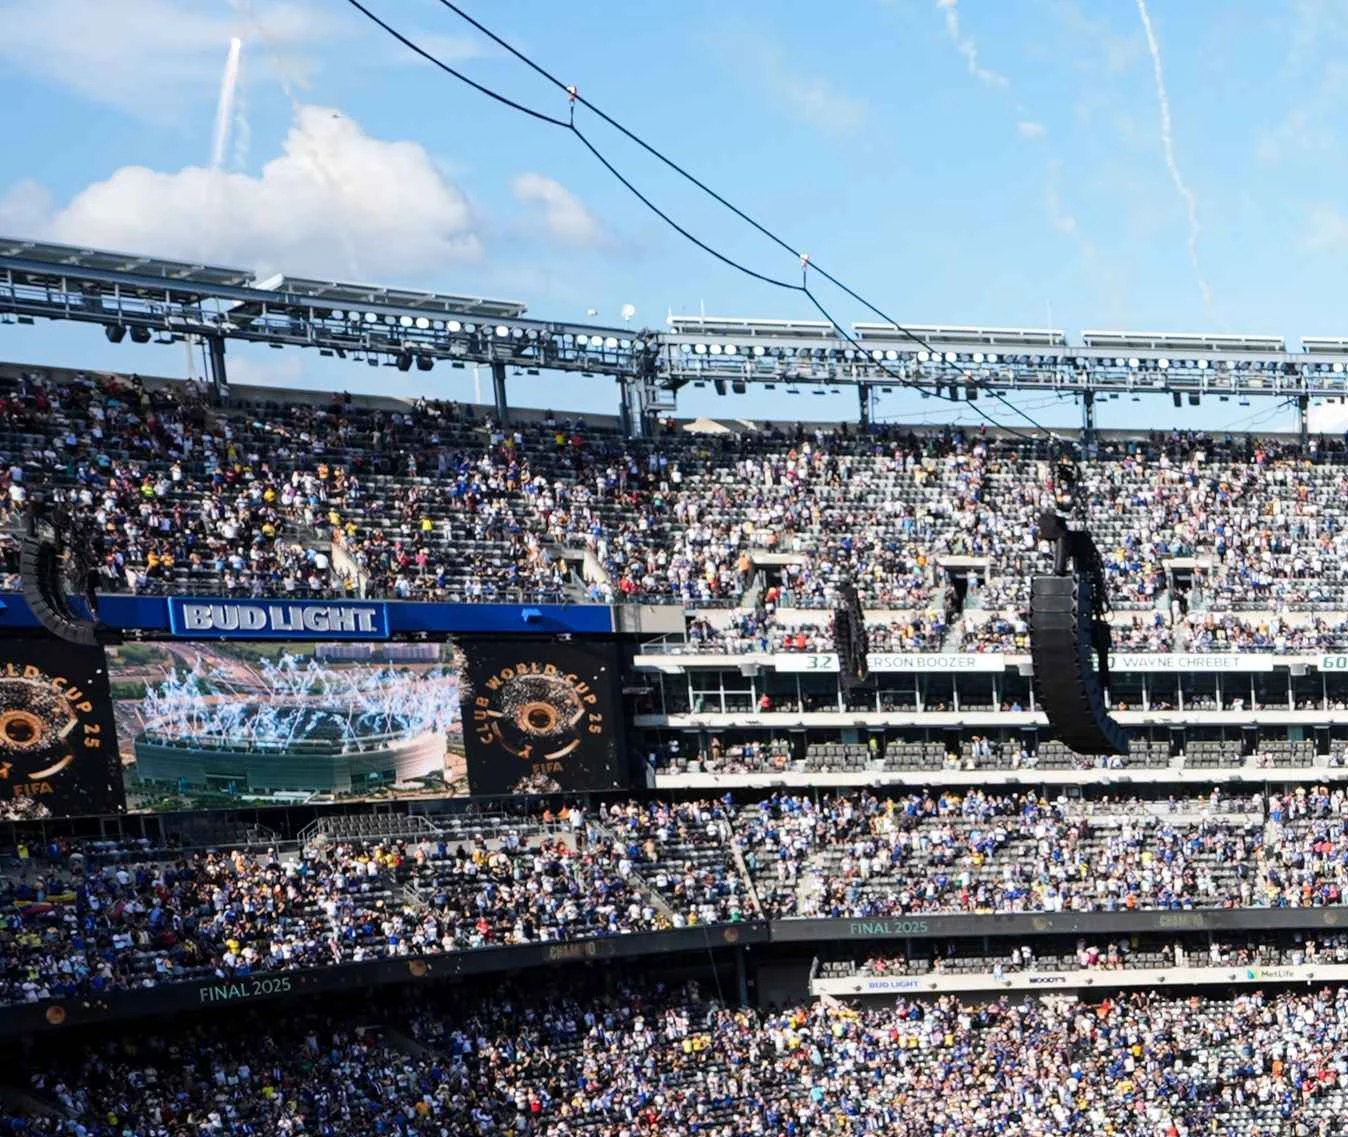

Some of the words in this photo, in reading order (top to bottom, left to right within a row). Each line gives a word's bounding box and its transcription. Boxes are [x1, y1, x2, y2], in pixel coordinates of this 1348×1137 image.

[183, 604, 266, 630] BUD
[269, 605, 377, 632] LIGHT
[807, 656, 832, 669] 32
[917, 657, 976, 667] BOOZER
[1123, 657, 1173, 667] WAYNE
[1179, 657, 1240, 667] CHREBET
[1323, 656, 1347, 668] 60
[52, 677, 93, 713] CUP
[473, 696, 493, 744] CLUB
[484, 662, 557, 690] WORLD
[565, 674, 597, 704] CUP
[532, 761, 563, 773] FIFA
[12, 782, 53, 797] FIFA
[850, 922, 891, 934] FINAL
[894, 921, 928, 934] 2025
[1261, 969, 1294, 978] MetLife
[199, 982, 250, 1002] FINAL
[253, 977, 292, 996] 2025
